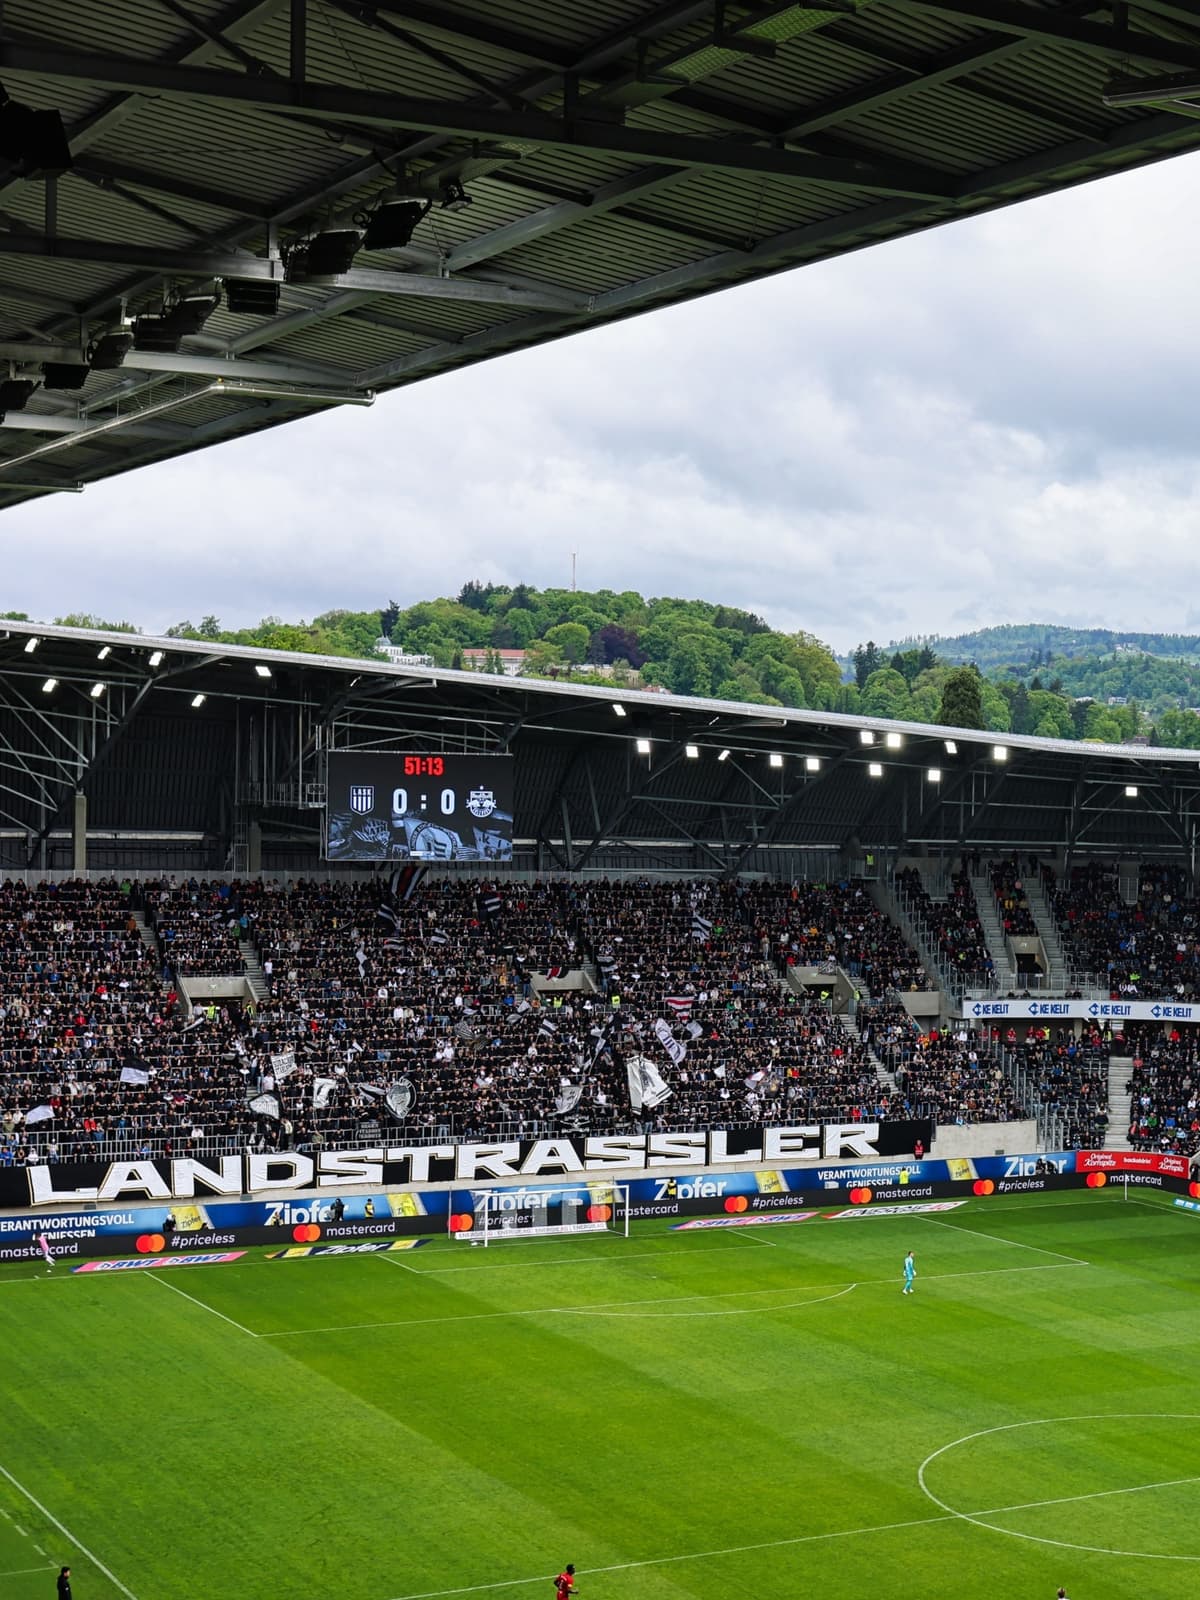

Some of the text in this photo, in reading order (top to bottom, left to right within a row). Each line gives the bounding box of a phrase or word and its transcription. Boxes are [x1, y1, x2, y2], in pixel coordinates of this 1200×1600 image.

[404, 756, 444, 776] 51:13
[393, 788, 408, 814] 0
[440, 788, 455, 815] 0
[983, 1004, 1009, 1014] KE KELIT
[1040, 1004, 1069, 1014] KE KELIT
[1100, 1004, 1131, 1016] KE KELIT
[1163, 1006, 1192, 1018] KE KELIT
[28, 1123, 880, 1206] LANDSTRASSLER
[1004, 1155, 1066, 1178] Zipr
[654, 1176, 728, 1200] Zpfer
[998, 1178, 1044, 1192] #priceless
[876, 1186, 932, 1199] mastercard
[752, 1195, 804, 1209] #priceless
[264, 1200, 348, 1226] Zipfe
[616, 1203, 678, 1216] mastercard
[0, 1214, 134, 1232] ERANTWORTUNGSVOLL
[327, 1222, 396, 1236] mastercard
[171, 1233, 235, 1248] #priceless
[0, 1242, 78, 1258] mastecard
